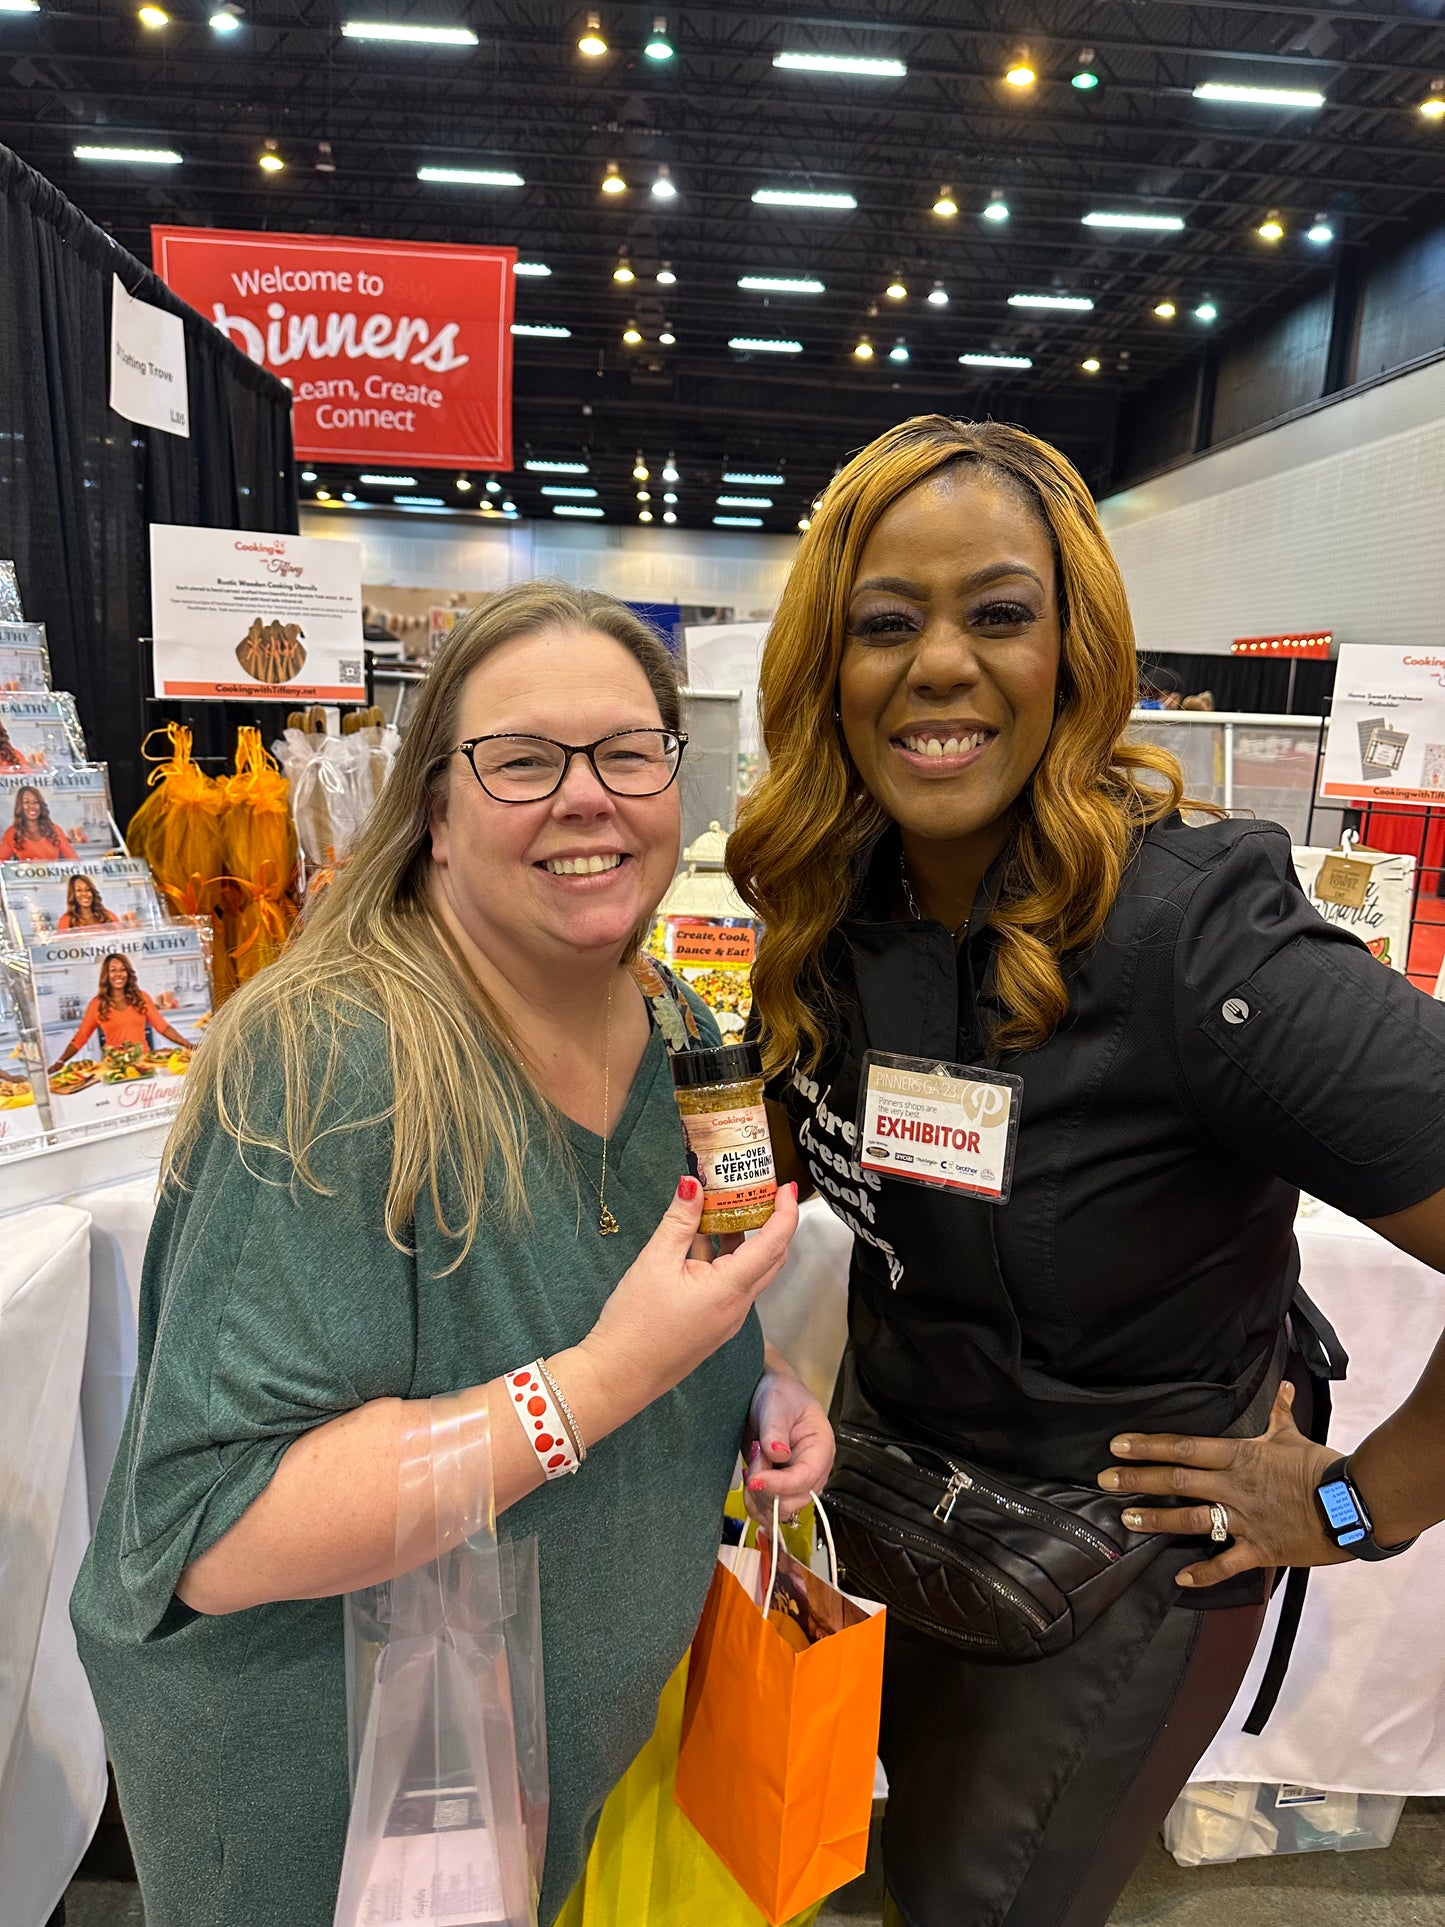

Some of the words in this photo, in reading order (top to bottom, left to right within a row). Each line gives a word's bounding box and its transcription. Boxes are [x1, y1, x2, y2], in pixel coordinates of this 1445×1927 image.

[232, 265, 352, 297] Welcome
[358, 271, 384, 296] to
[365, 375, 443, 408] Create
[316, 404, 417, 432] Connect
[235, 541, 275, 555] Cooking
[267, 559, 304, 578] Tiffany
[215, 683, 317, 697] CookingwithTiffany.net
[14, 865, 83, 878] COOKING
[84, 863, 141, 876] HEALTHY
[676, 930, 716, 942] Create,
[718, 932, 750, 944] Cook,
[46, 943, 118, 961] COOKING
[122, 937, 189, 954] HEALTHY
[676, 945, 711, 955] Dance
[715, 947, 725, 956] &
[726, 947, 750, 957] Eat!
[876, 1072, 921, 1092] PINNERS
[923, 1081, 940, 1097] GA
[878, 1104, 889, 1113] the
[889, 1108, 905, 1118] very
[879, 1096, 904, 1108] Pinners
[904, 1101, 924, 1113] shops
[925, 1105, 938, 1114] are
[711, 1115, 746, 1127] Cooking
[876, 1114, 981, 1154] EXHIBITOR
[722, 1146, 767, 1163] ALL-OVER
[715, 1154, 773, 1176] EVERYTHING
[956, 1164, 978, 1174] brother
[723, 1167, 770, 1183] SEASONING
[809, 1159, 876, 1224] Cook
